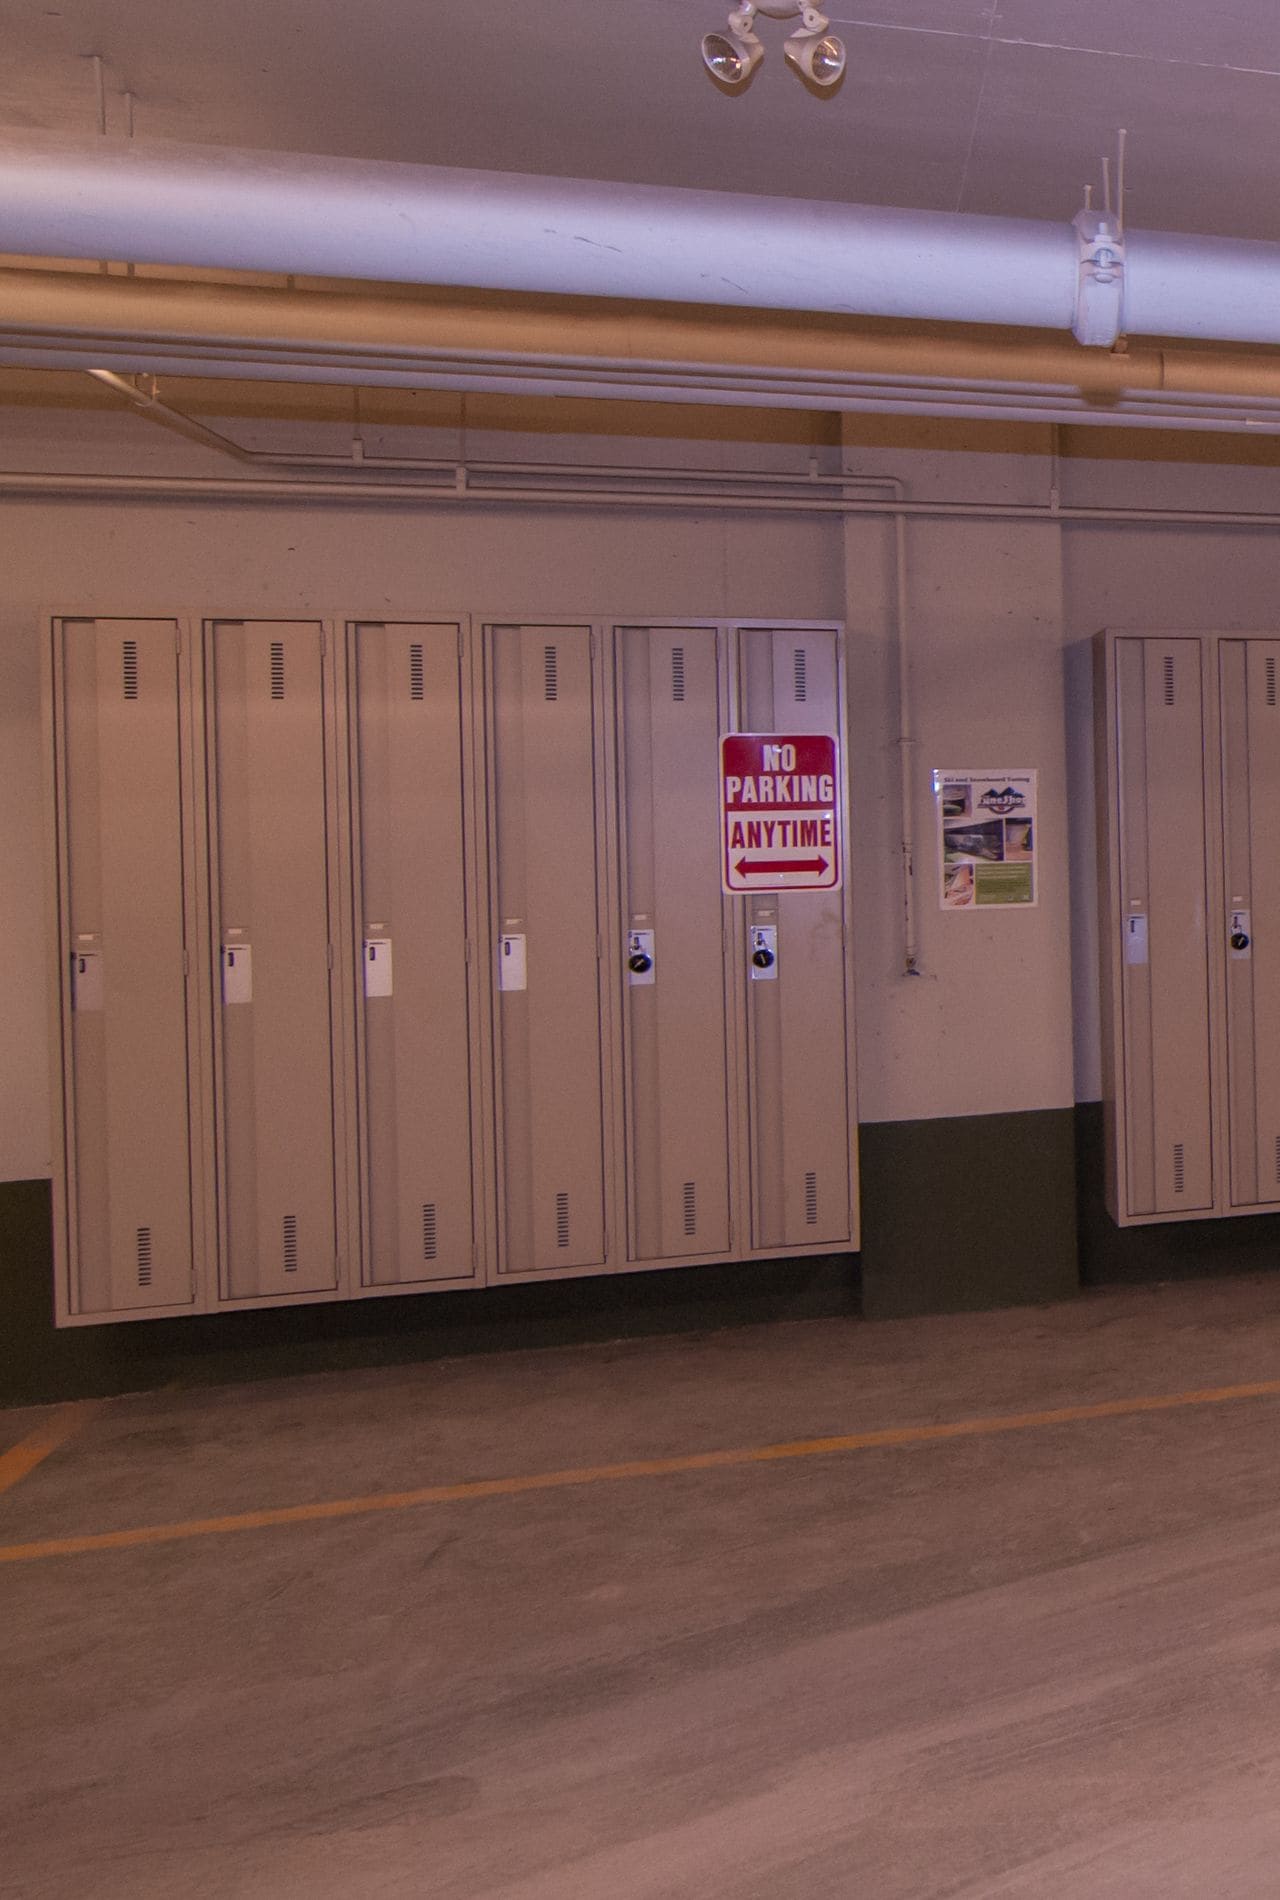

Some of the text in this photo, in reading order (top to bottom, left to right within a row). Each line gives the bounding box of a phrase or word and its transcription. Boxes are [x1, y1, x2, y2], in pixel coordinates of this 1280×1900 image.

[762, 744, 797, 772] NO
[726, 774, 834, 804] PARKING
[732, 820, 832, 849] ANYTIME
